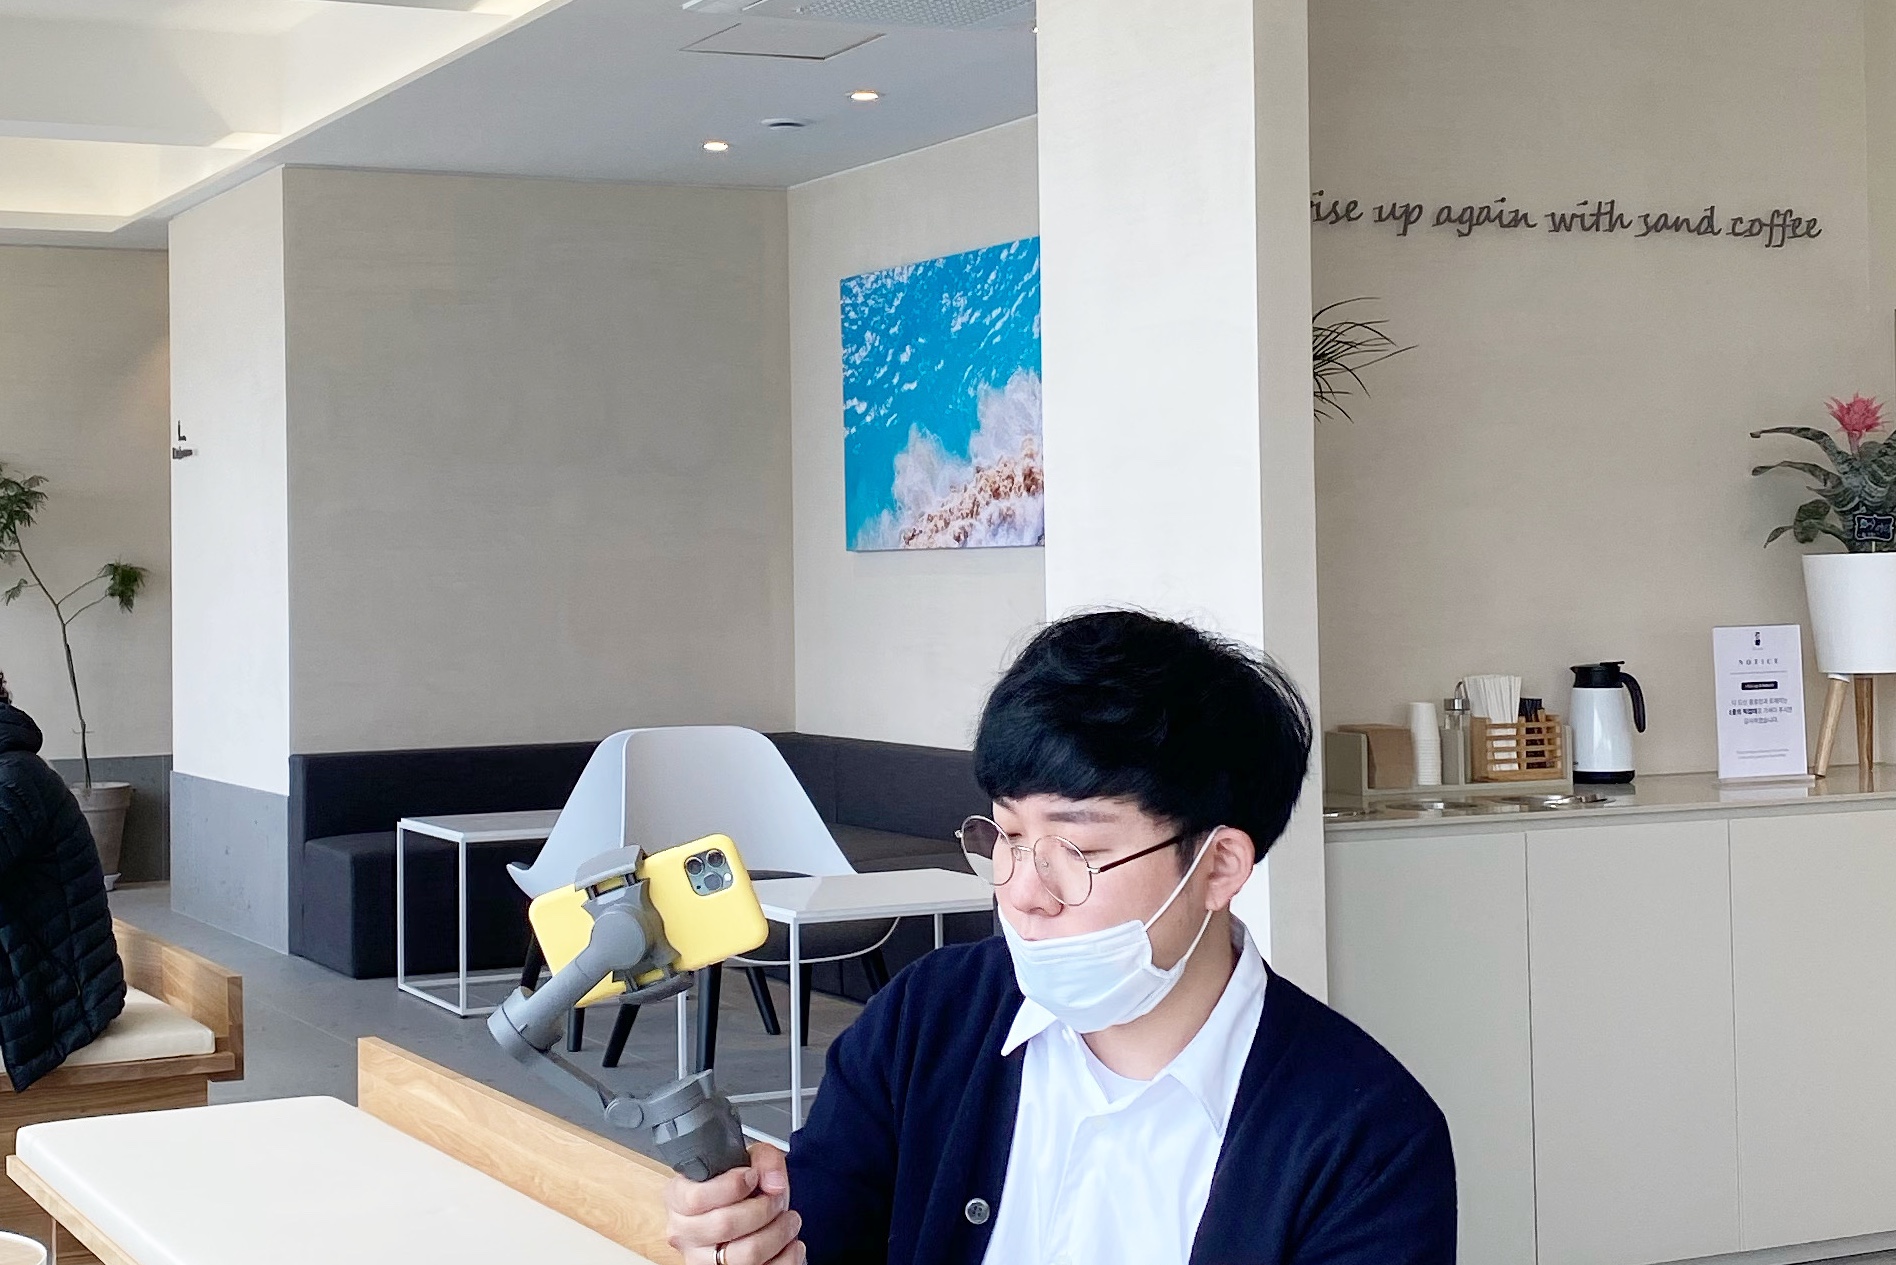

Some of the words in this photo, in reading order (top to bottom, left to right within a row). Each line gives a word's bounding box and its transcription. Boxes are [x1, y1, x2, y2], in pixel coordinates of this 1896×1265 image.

[1373, 201, 1423, 237] up
[1432, 196, 1538, 238] again
[1544, 200, 1633, 233] with
[1634, 205, 1722, 238] sand
[1726, 208, 1823, 248] coffee
